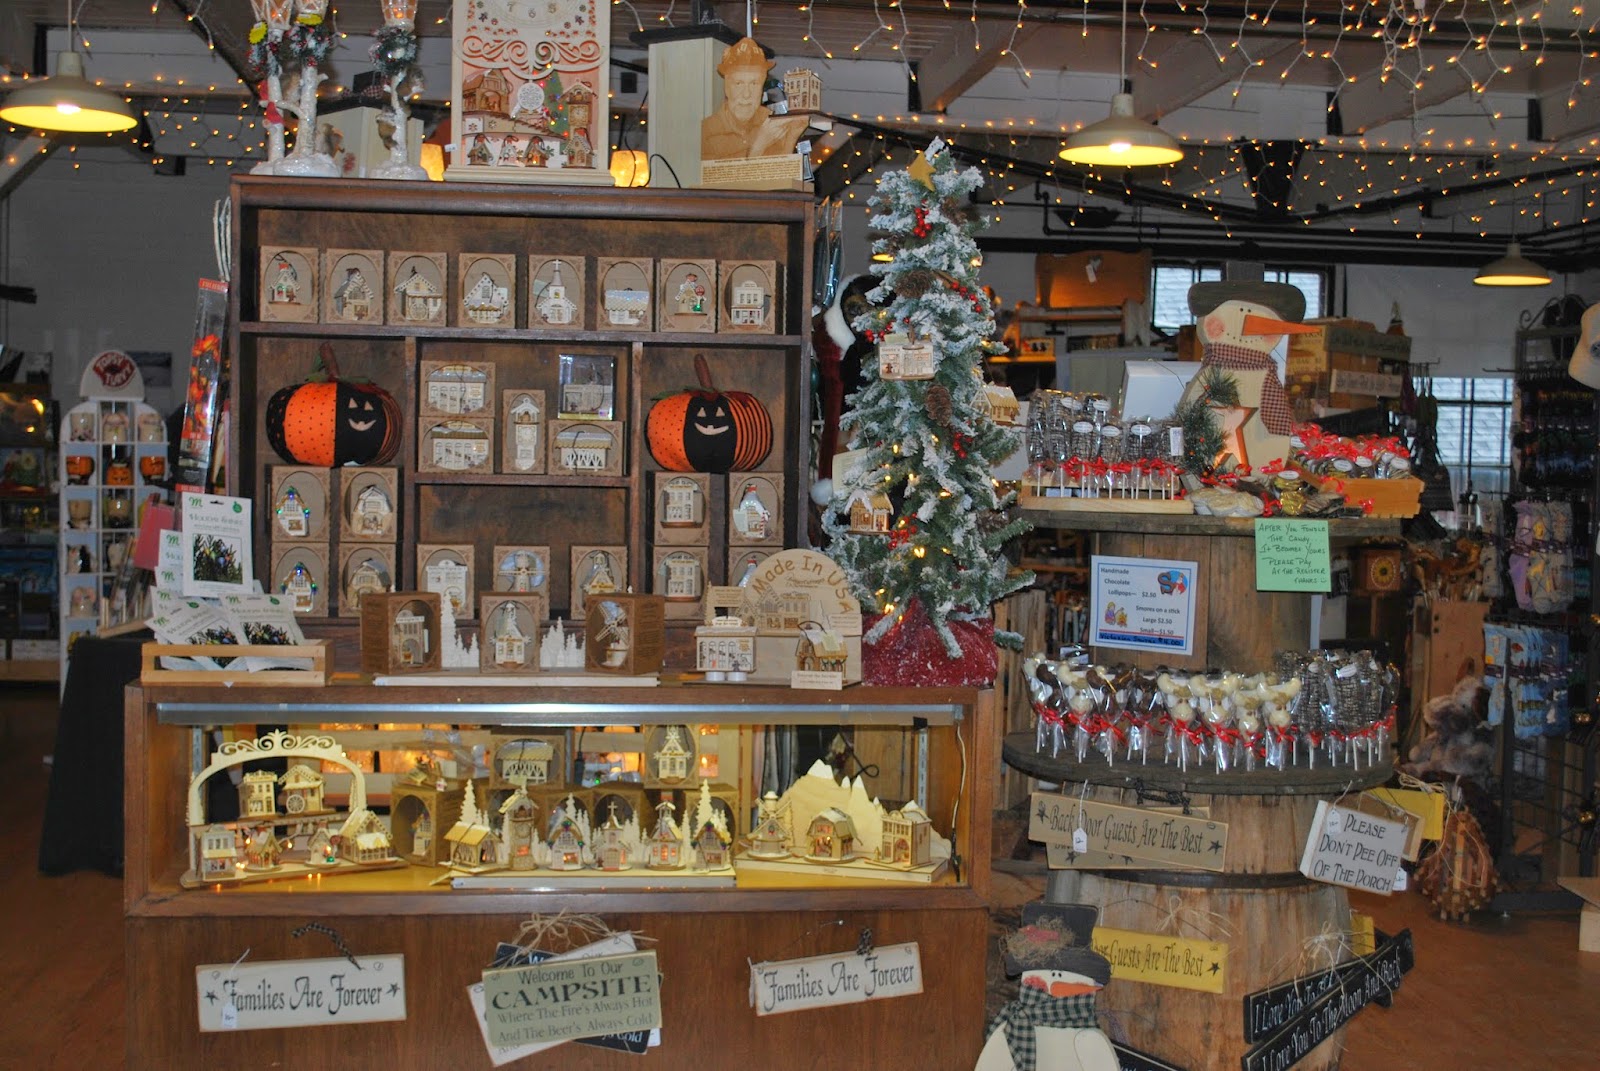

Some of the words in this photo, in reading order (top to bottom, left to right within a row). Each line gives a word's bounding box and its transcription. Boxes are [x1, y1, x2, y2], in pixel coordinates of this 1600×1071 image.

[1258, 524, 1282, 532] AFTER
[1301, 524, 1326, 532] FONDLE
[1101, 567, 1130, 575] Handmade
[1262, 557, 1295, 566] PLEASE
[1295, 567, 1326, 575] REGISTER
[752, 559, 795, 595] Made
[802, 555, 824, 576] In
[828, 570, 855, 614] USA
[1143, 617, 1157, 625] Large
[1048, 804, 1076, 832] Back
[1104, 814, 1138, 850] Guests
[1137, 819, 1157, 849] Are
[1160, 820, 1179, 850] The
[1180, 825, 1204, 854] Best
[1344, 813, 1387, 839] PLEASE
[1319, 834, 1353, 856] DON'T
[1353, 842, 1376, 863] PEE
[1376, 849, 1399, 868] OFF
[1313, 860, 1331, 878] OF
[1333, 863, 1355, 883] THE
[1355, 869, 1391, 892] PORCH
[517, 968, 575, 986] Welcome
[581, 964, 596, 979] To
[601, 961, 624, 976] Our
[1110, 940, 1141, 976] Guests
[1141, 944, 1161, 973] Are
[1162, 942, 1181, 974] The
[1182, 948, 1204, 977] Best
[222, 978, 287, 1013] Families
[289, 976, 324, 1011] Are
[328, 973, 383, 1016] Forever
[492, 974, 652, 1011] CAMPSITE
[763, 967, 824, 1013] Families
[827, 961, 859, 997] Are
[864, 956, 915, 997] Forever
[497, 1011, 534, 1025] Where
[536, 1007, 560, 1021] The
[561, 1003, 591, 1018] Fire's
[593, 999, 630, 1016] Always
[632, 996, 654, 1010] Hot
[1262, 1001, 1284, 1031] Love
[1269, 1044, 1291, 1071] Love
[1291, 1027, 1309, 1060] You
[1310, 1014, 1322, 1043] To
[1322, 999, 1338, 1035] The
[1337, 989, 1362, 1023] Moon
[1362, 961, 1381, 1007] And
[1380, 947, 1402, 987] Back
[497, 1030, 523, 1044] And
[523, 1026, 546, 1040] The
[548, 1021, 582, 1037] Beer's
[587, 1019, 625, 1034] Always
[627, 1013, 654, 1028] Cold
